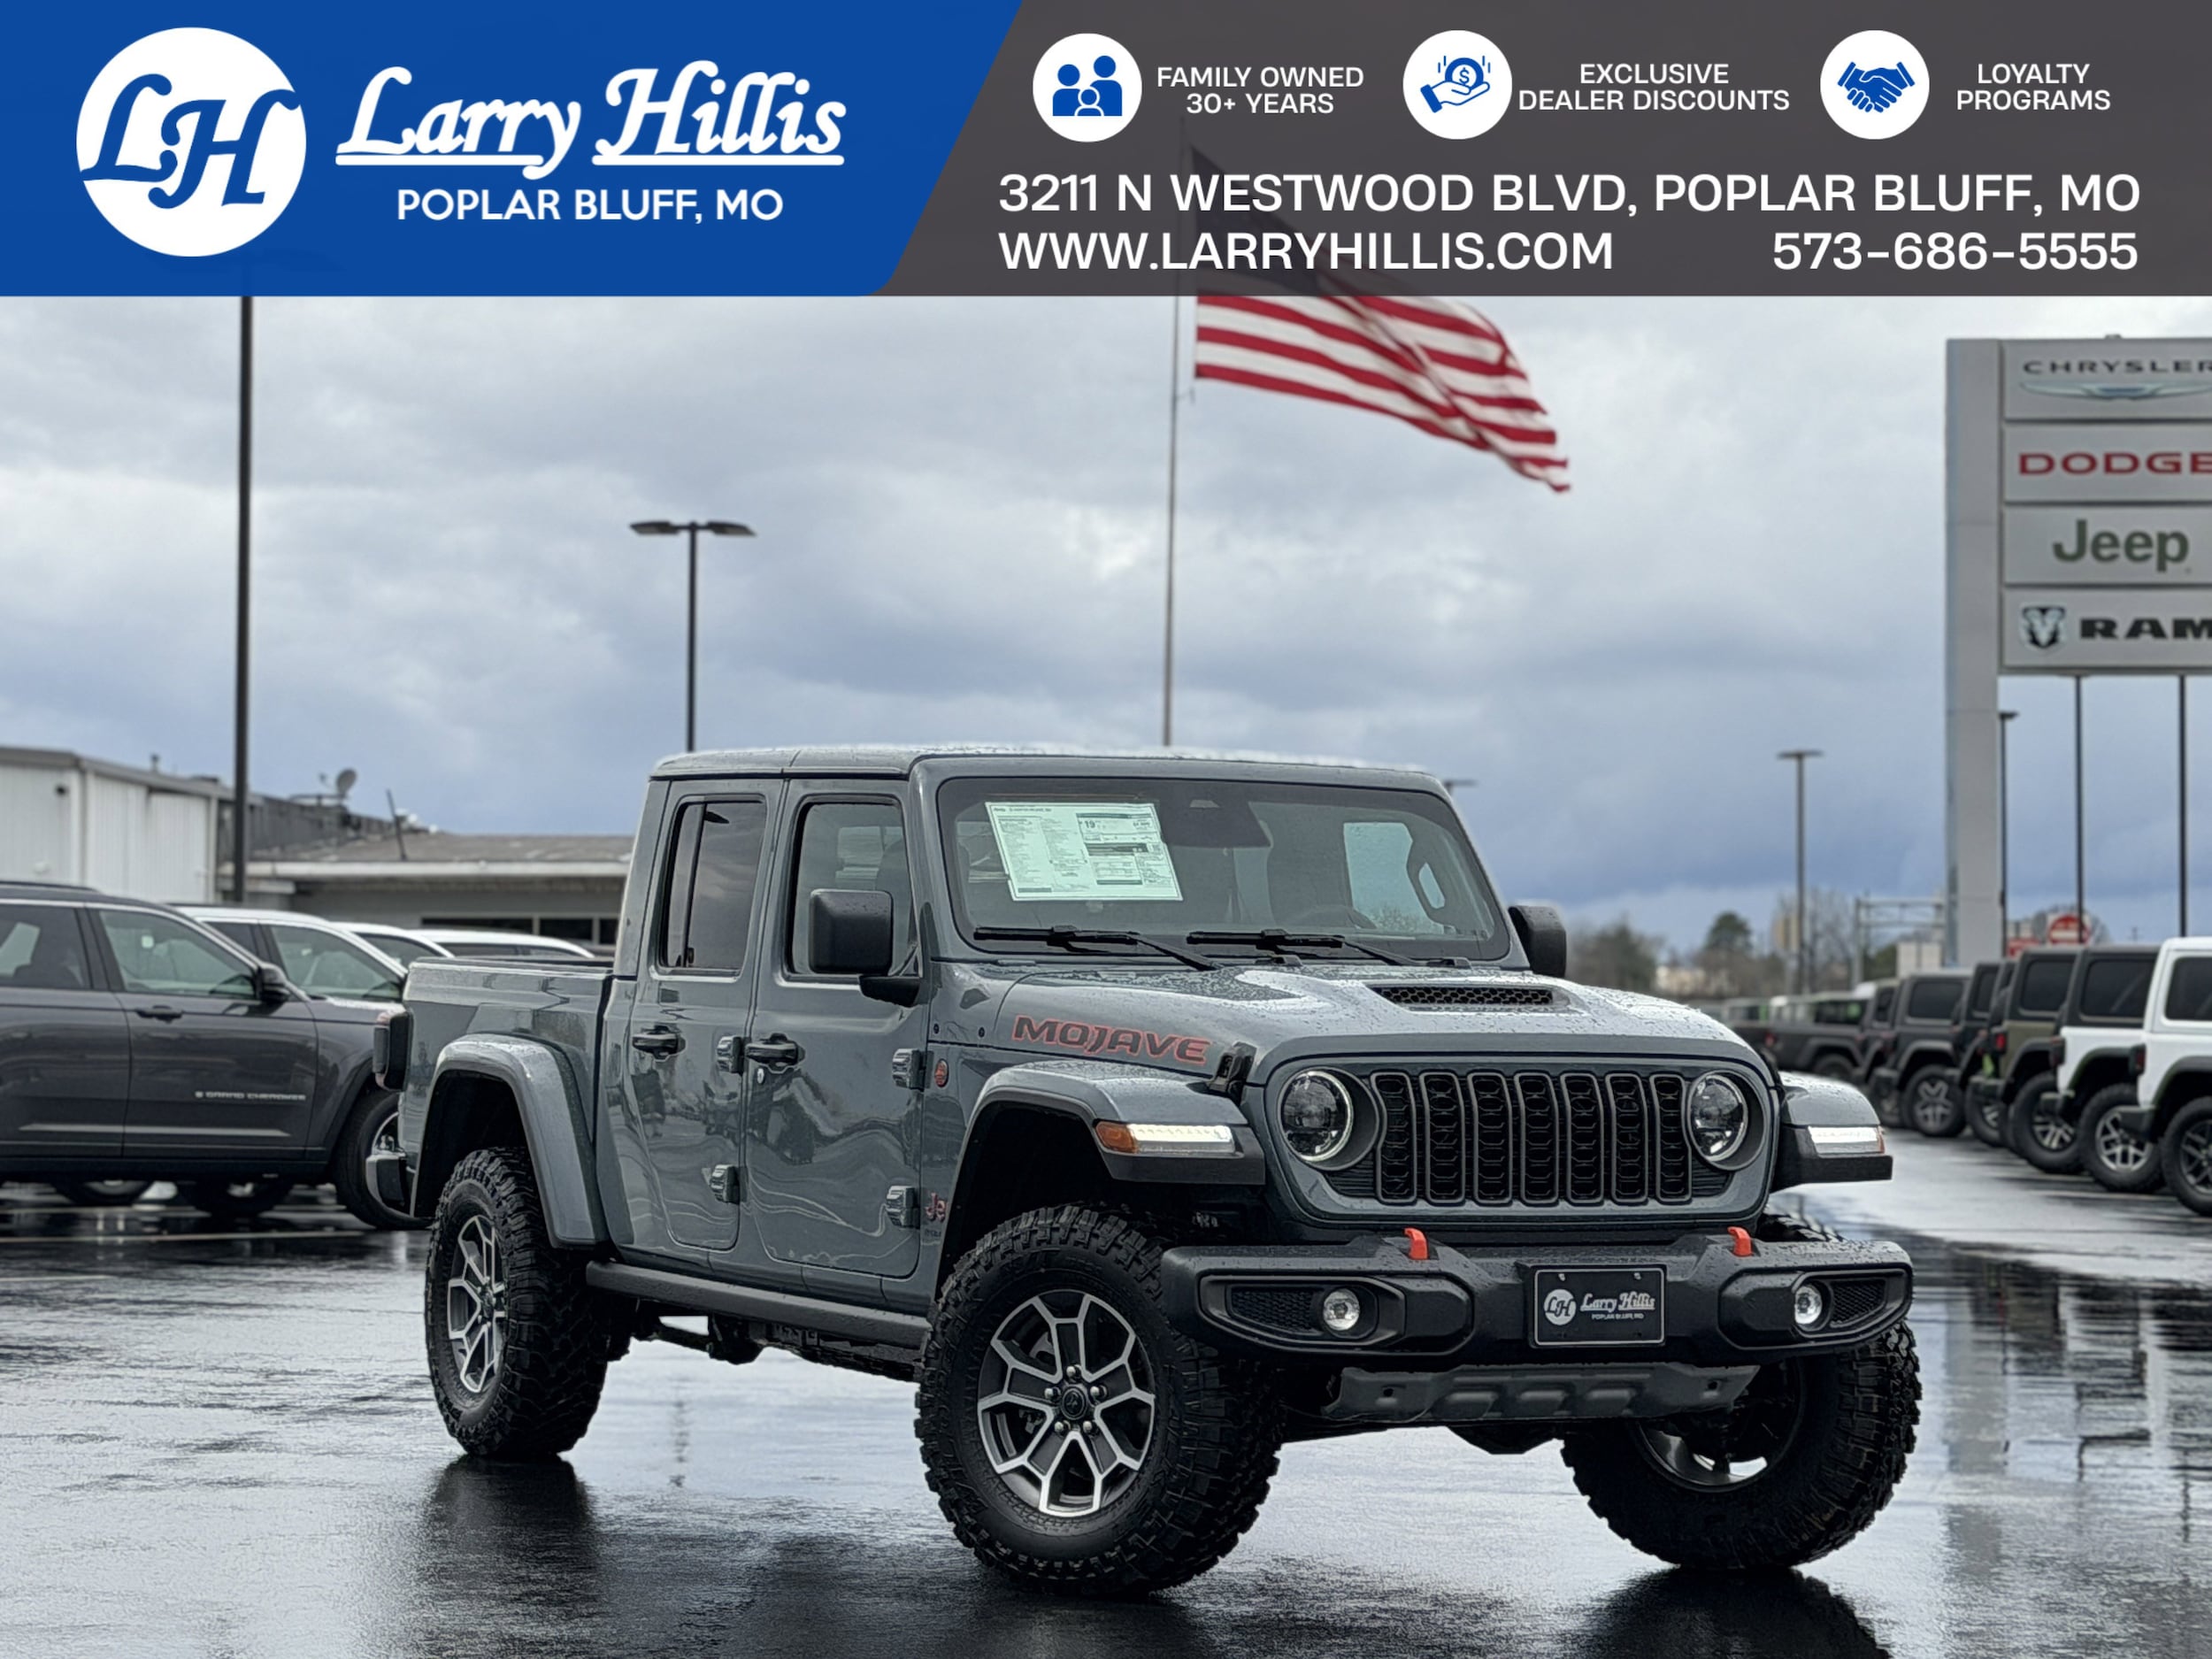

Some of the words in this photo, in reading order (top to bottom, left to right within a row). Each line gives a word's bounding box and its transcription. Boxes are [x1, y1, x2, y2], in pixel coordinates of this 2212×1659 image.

[2023, 359, 2212, 374] CHRYSLER
[2019, 452, 2212, 475] DODGE
[2052, 518, 2190, 572] Jeep
[2080, 618, 2212, 640] RAM
[1012, 1014, 1212, 1066] MOJAVE
[1579, 1293, 1617, 1313] Larry
[1617, 1291, 1656, 1311] Hillis
